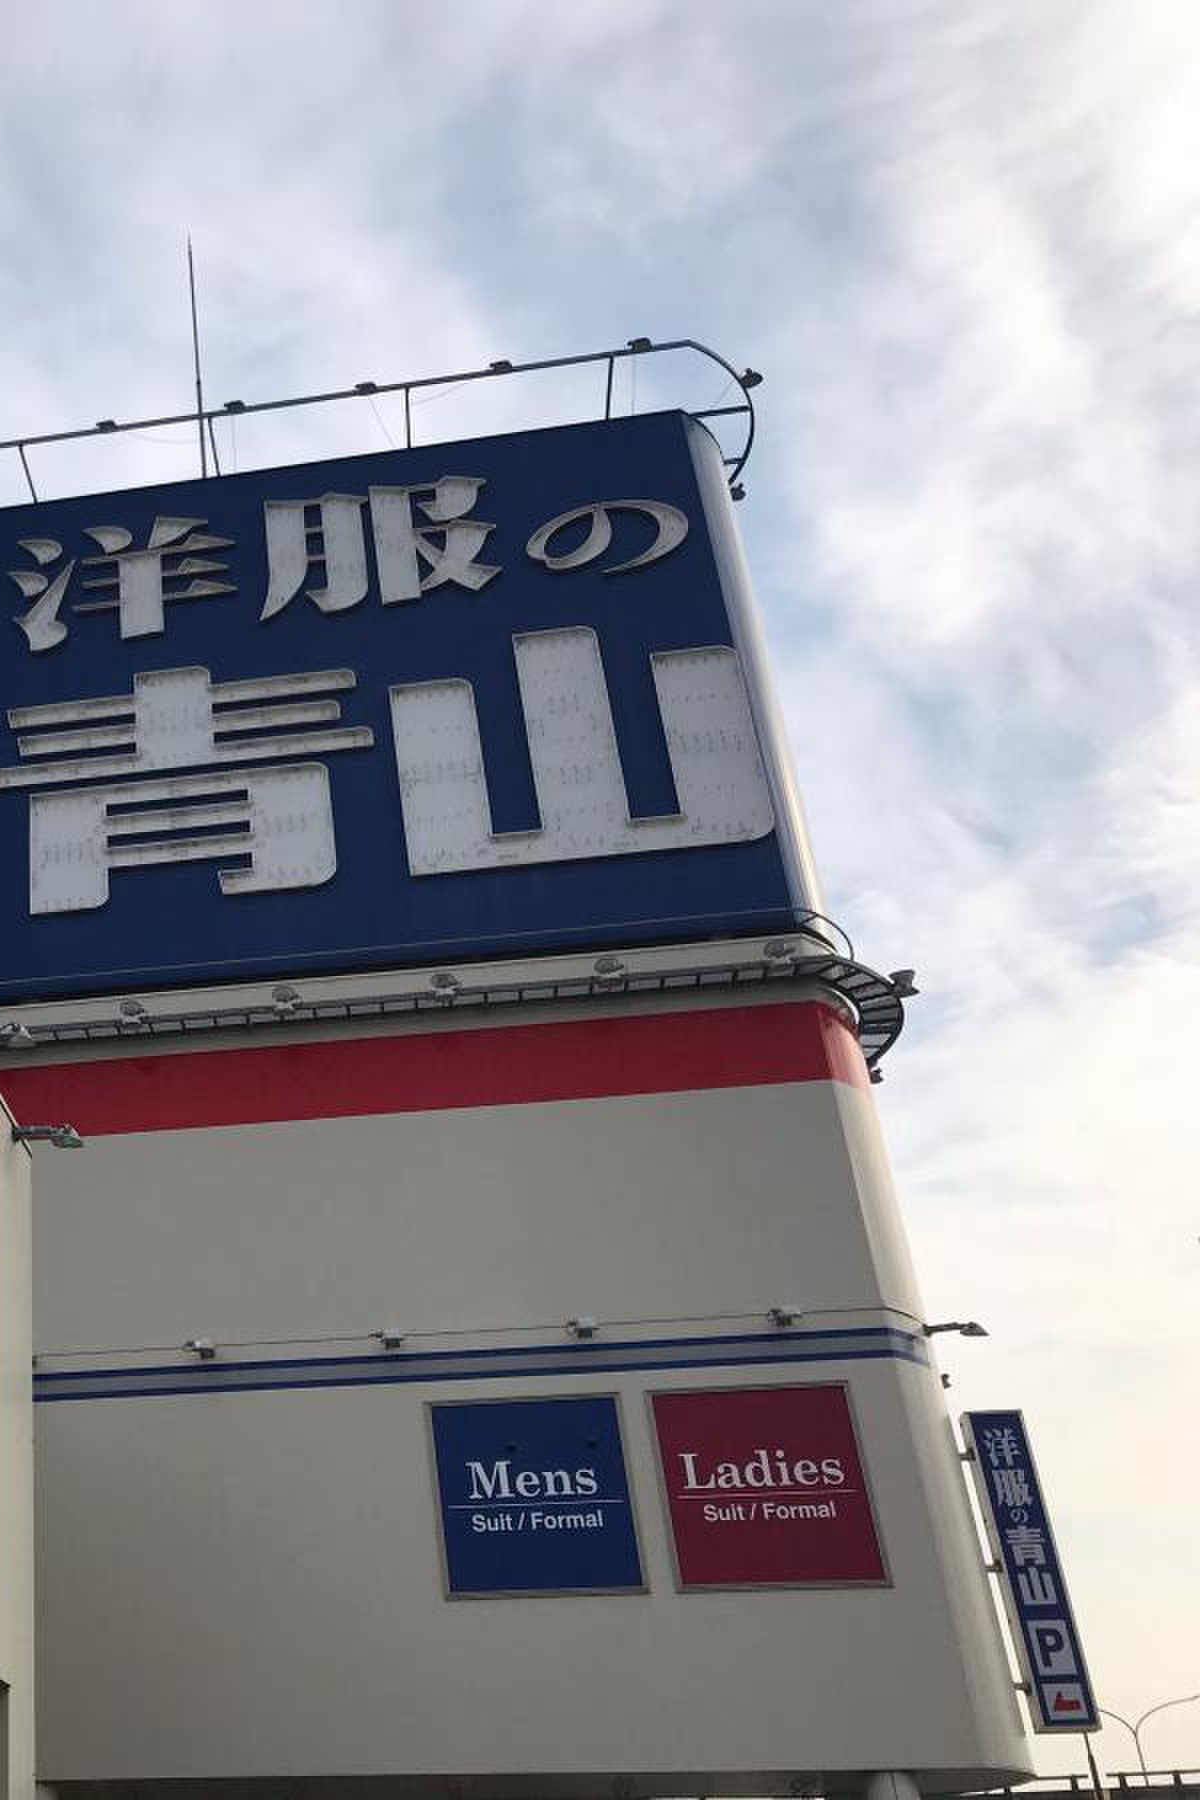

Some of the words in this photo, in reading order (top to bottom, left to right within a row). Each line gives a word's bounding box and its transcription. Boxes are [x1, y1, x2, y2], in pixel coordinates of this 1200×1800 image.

[7, 474, 691, 654] 洋服の
[465, 1459, 599, 1500] Mens
[677, 1449, 846, 1490] Ladies
[471, 1511, 513, 1533] Suit
[531, 1509, 604, 1531] Formal
[703, 1503, 744, 1522] Suit
[763, 1500, 837, 1520] Formal
[982, 1427, 1058, 1606] 洋服の青山
[1035, 1627, 1065, 1668] P
